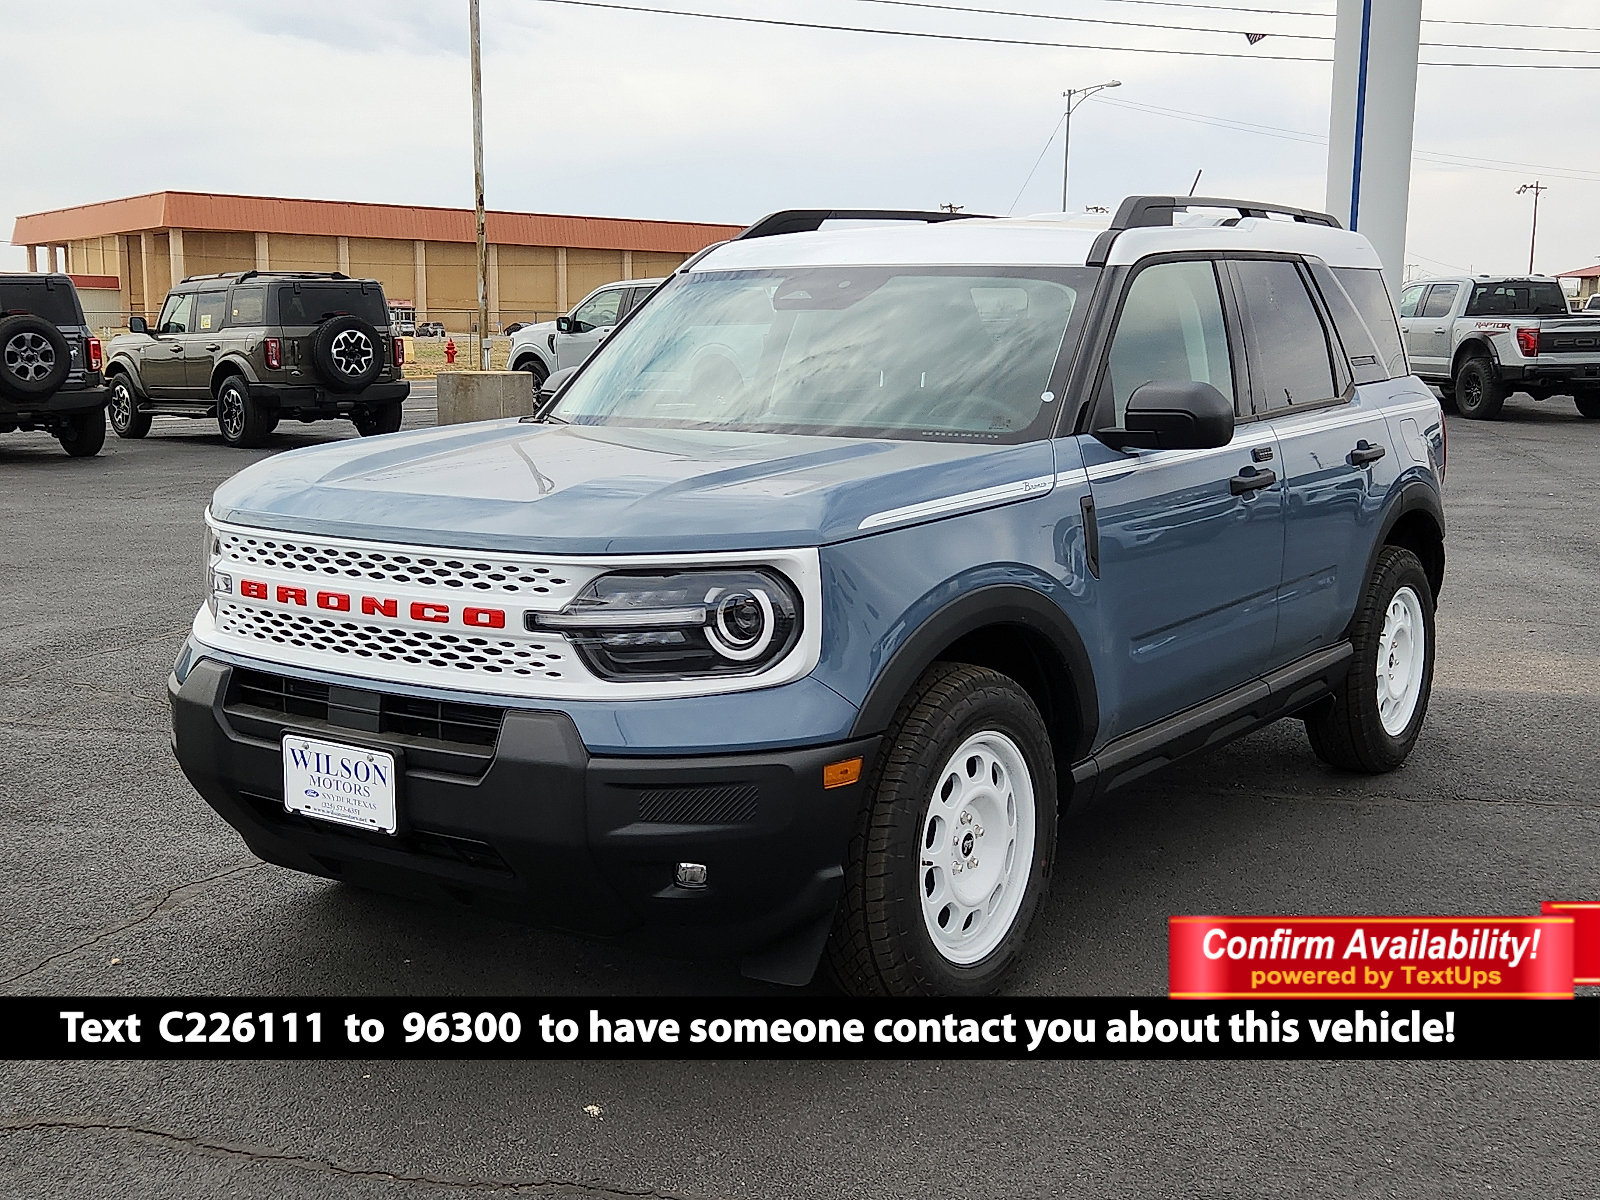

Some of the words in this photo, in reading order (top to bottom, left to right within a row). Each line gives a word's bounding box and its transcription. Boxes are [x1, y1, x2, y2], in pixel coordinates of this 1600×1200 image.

[1475, 322, 1511, 330] RAPTOR
[240, 578, 506, 629] BRONCO
[290, 748, 388, 787] WILSON
[309, 775, 370, 797] MOTORS
